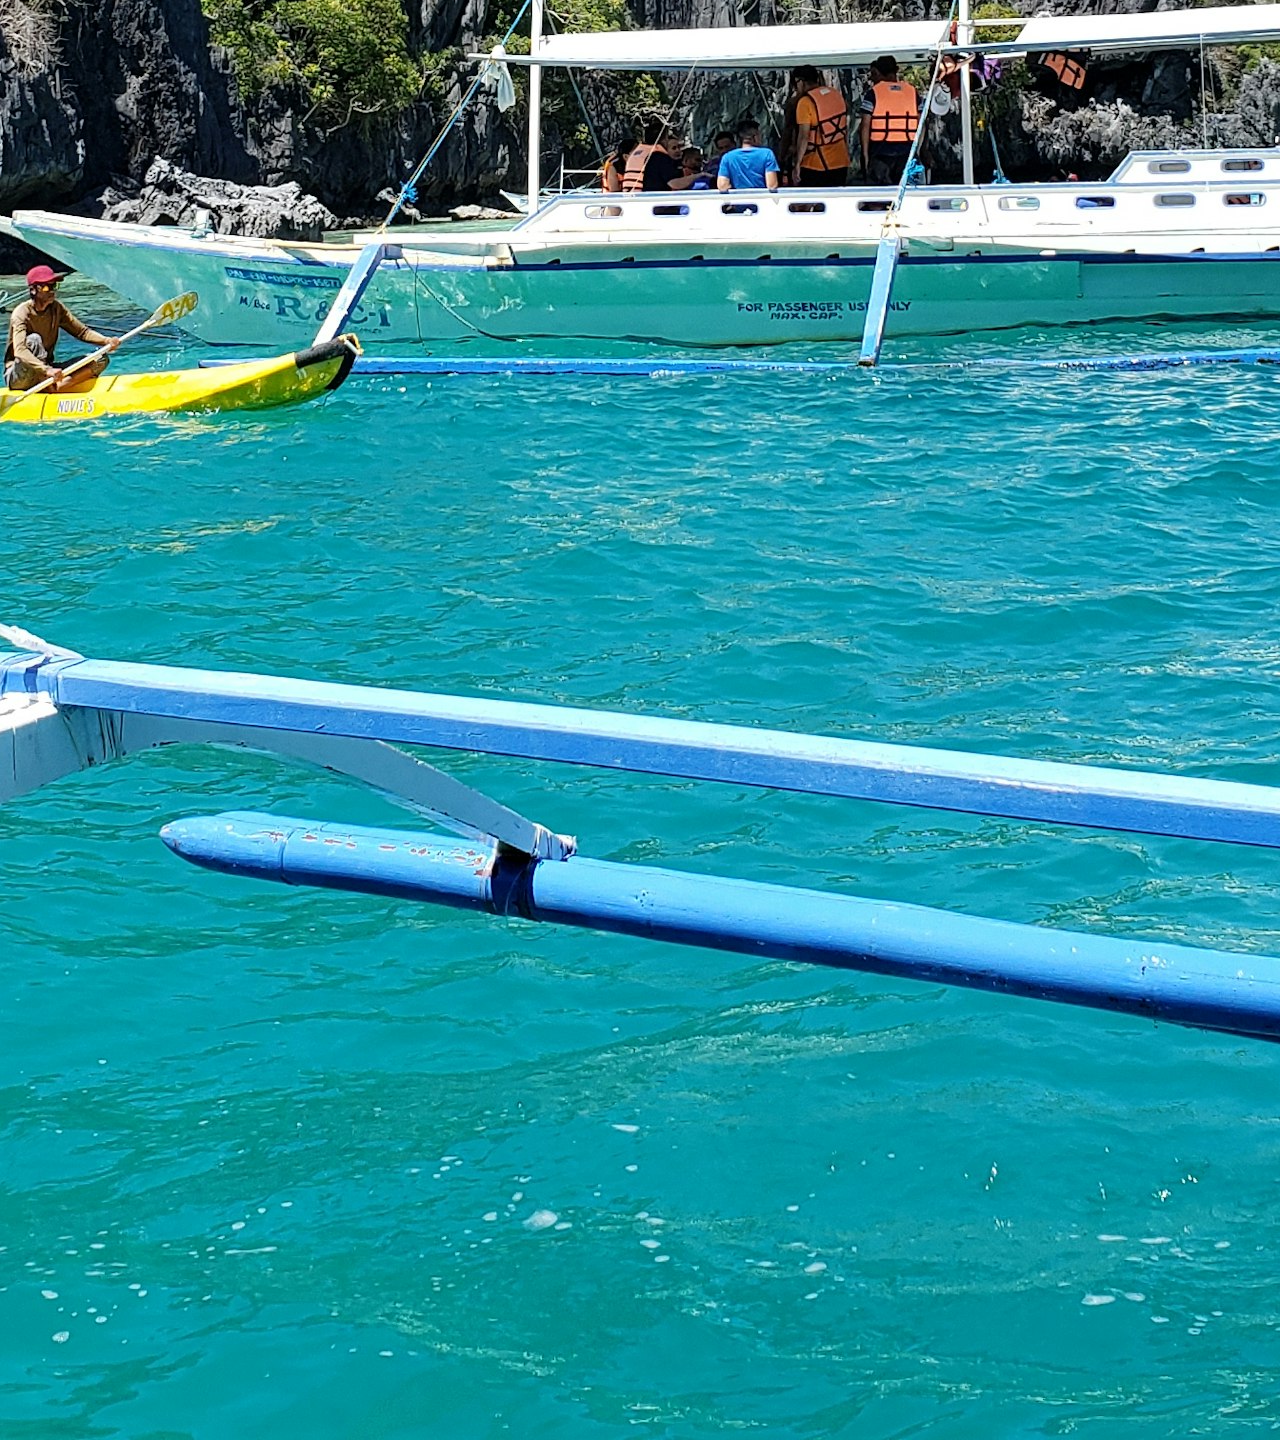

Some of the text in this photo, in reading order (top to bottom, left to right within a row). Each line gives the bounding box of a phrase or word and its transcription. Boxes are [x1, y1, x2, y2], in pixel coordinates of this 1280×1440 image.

[273, 294, 311, 320] R
[738, 303, 764, 312] FOR
[768, 302, 843, 312] PASSENGER
[886, 301, 912, 311] NLY
